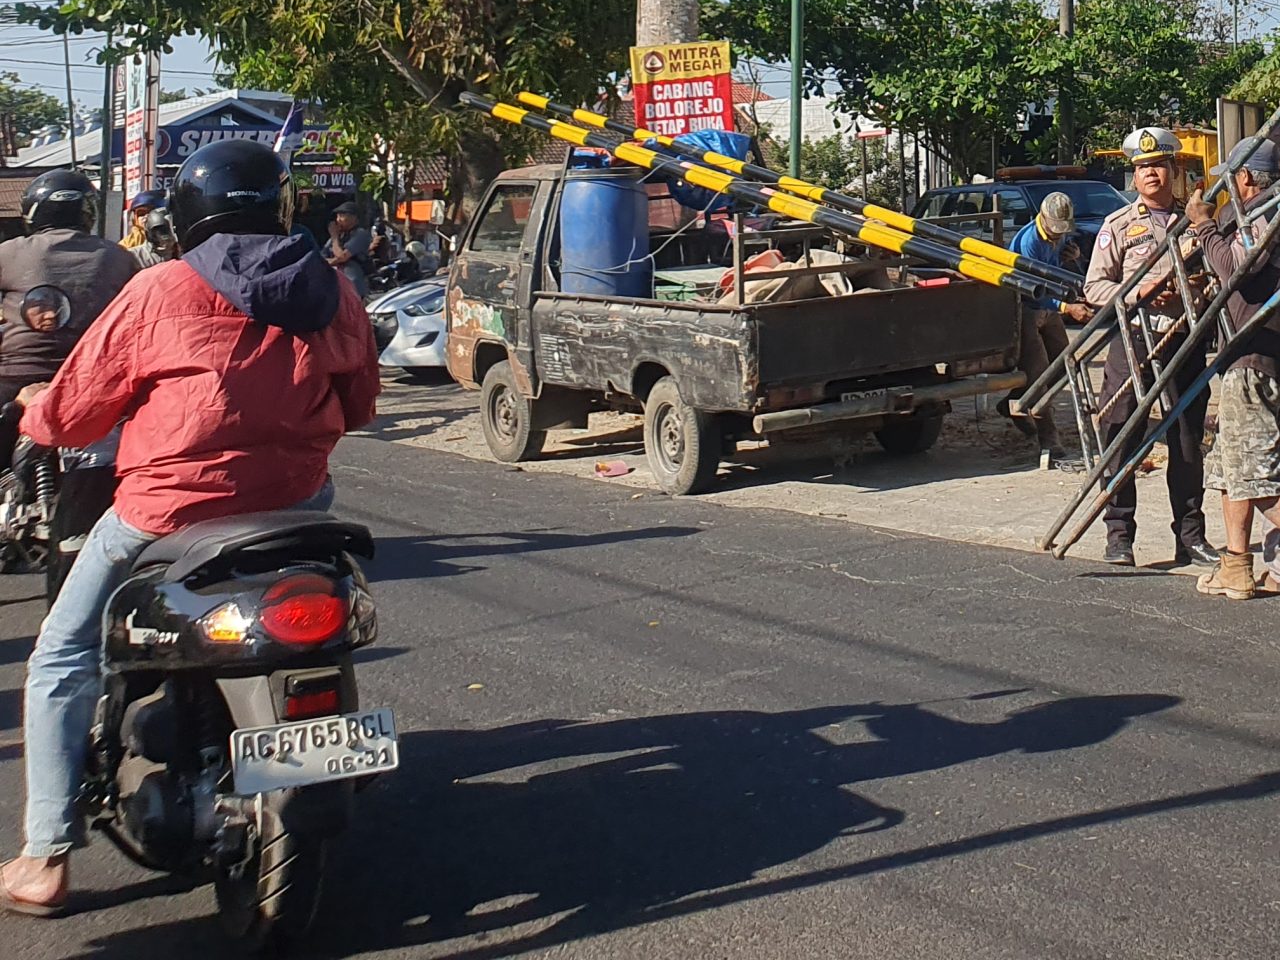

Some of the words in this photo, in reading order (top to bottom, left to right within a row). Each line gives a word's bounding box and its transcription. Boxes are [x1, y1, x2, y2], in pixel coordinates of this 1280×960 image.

[668, 46, 721, 61] MITRA
[669, 59, 722, 73] MEGAH
[652, 81, 714, 100] CABANG
[645, 98, 724, 118] BOLOREJO
[645, 119, 685, 135] TETAP
[689, 115, 725, 133] BUKA
[240, 731, 273, 762] AG
[275, 720, 342, 754] 6765
[346, 712, 391, 745] RGL
